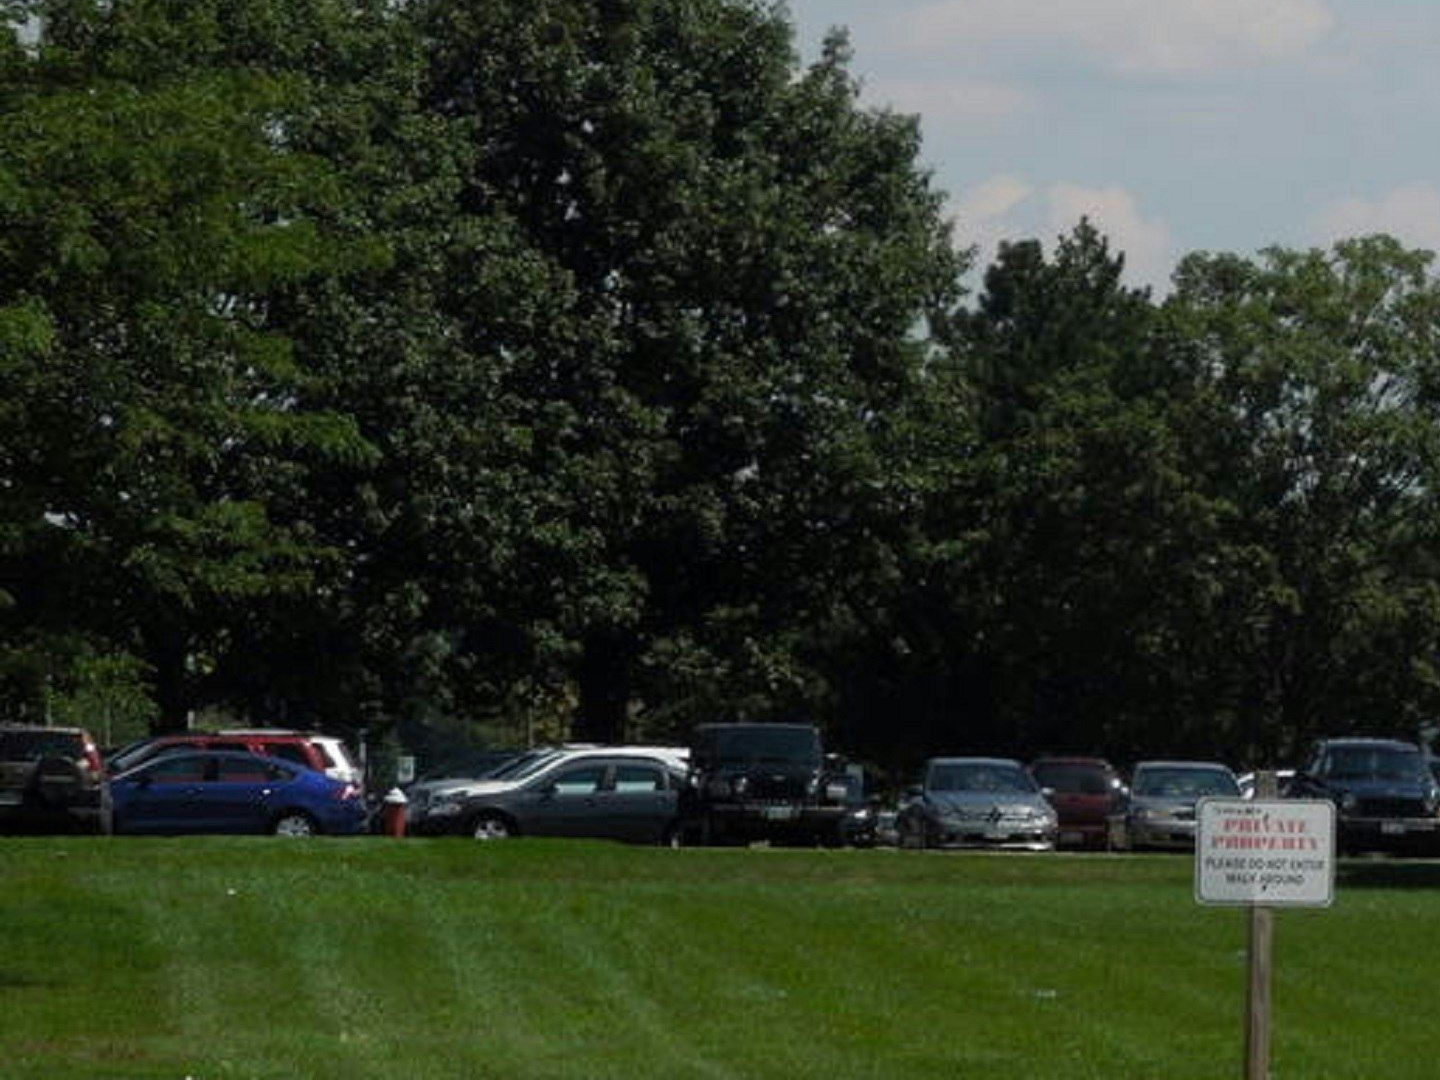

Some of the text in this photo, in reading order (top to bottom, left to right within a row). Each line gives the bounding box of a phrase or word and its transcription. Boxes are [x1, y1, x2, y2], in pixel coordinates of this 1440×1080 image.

[1222, 818, 1306, 833] PRIVATE
[1212, 834, 1324, 850] PROPERTY
[1206, 857, 1325, 869] PLEASE DO NOT ENTER
[1225, 872, 1305, 885] WALK AROUND
